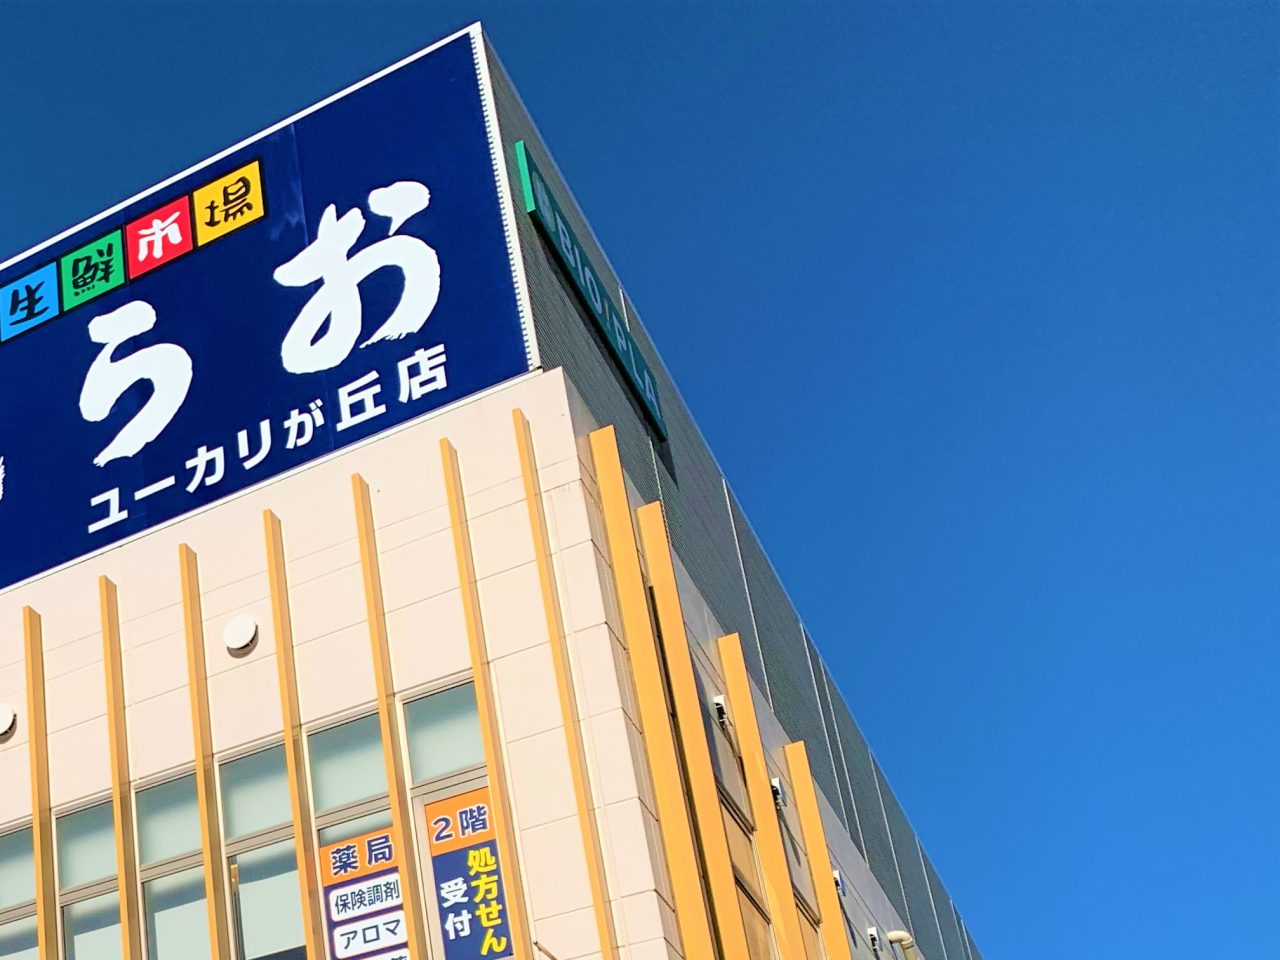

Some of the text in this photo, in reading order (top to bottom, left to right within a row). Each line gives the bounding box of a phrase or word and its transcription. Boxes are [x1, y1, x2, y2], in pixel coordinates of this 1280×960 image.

[8, 176, 255, 326] 生鮮市場
[87, 344, 449, 534] ユーカリが丘店
[432, 804, 489, 844] 2階
[331, 834, 394, 877] 薬局
[334, 877, 401, 916] 保険調剤
[440, 876, 473, 941] 受付
[467, 846, 507, 957] 処方せん
[339, 918, 401, 950] アロマ
